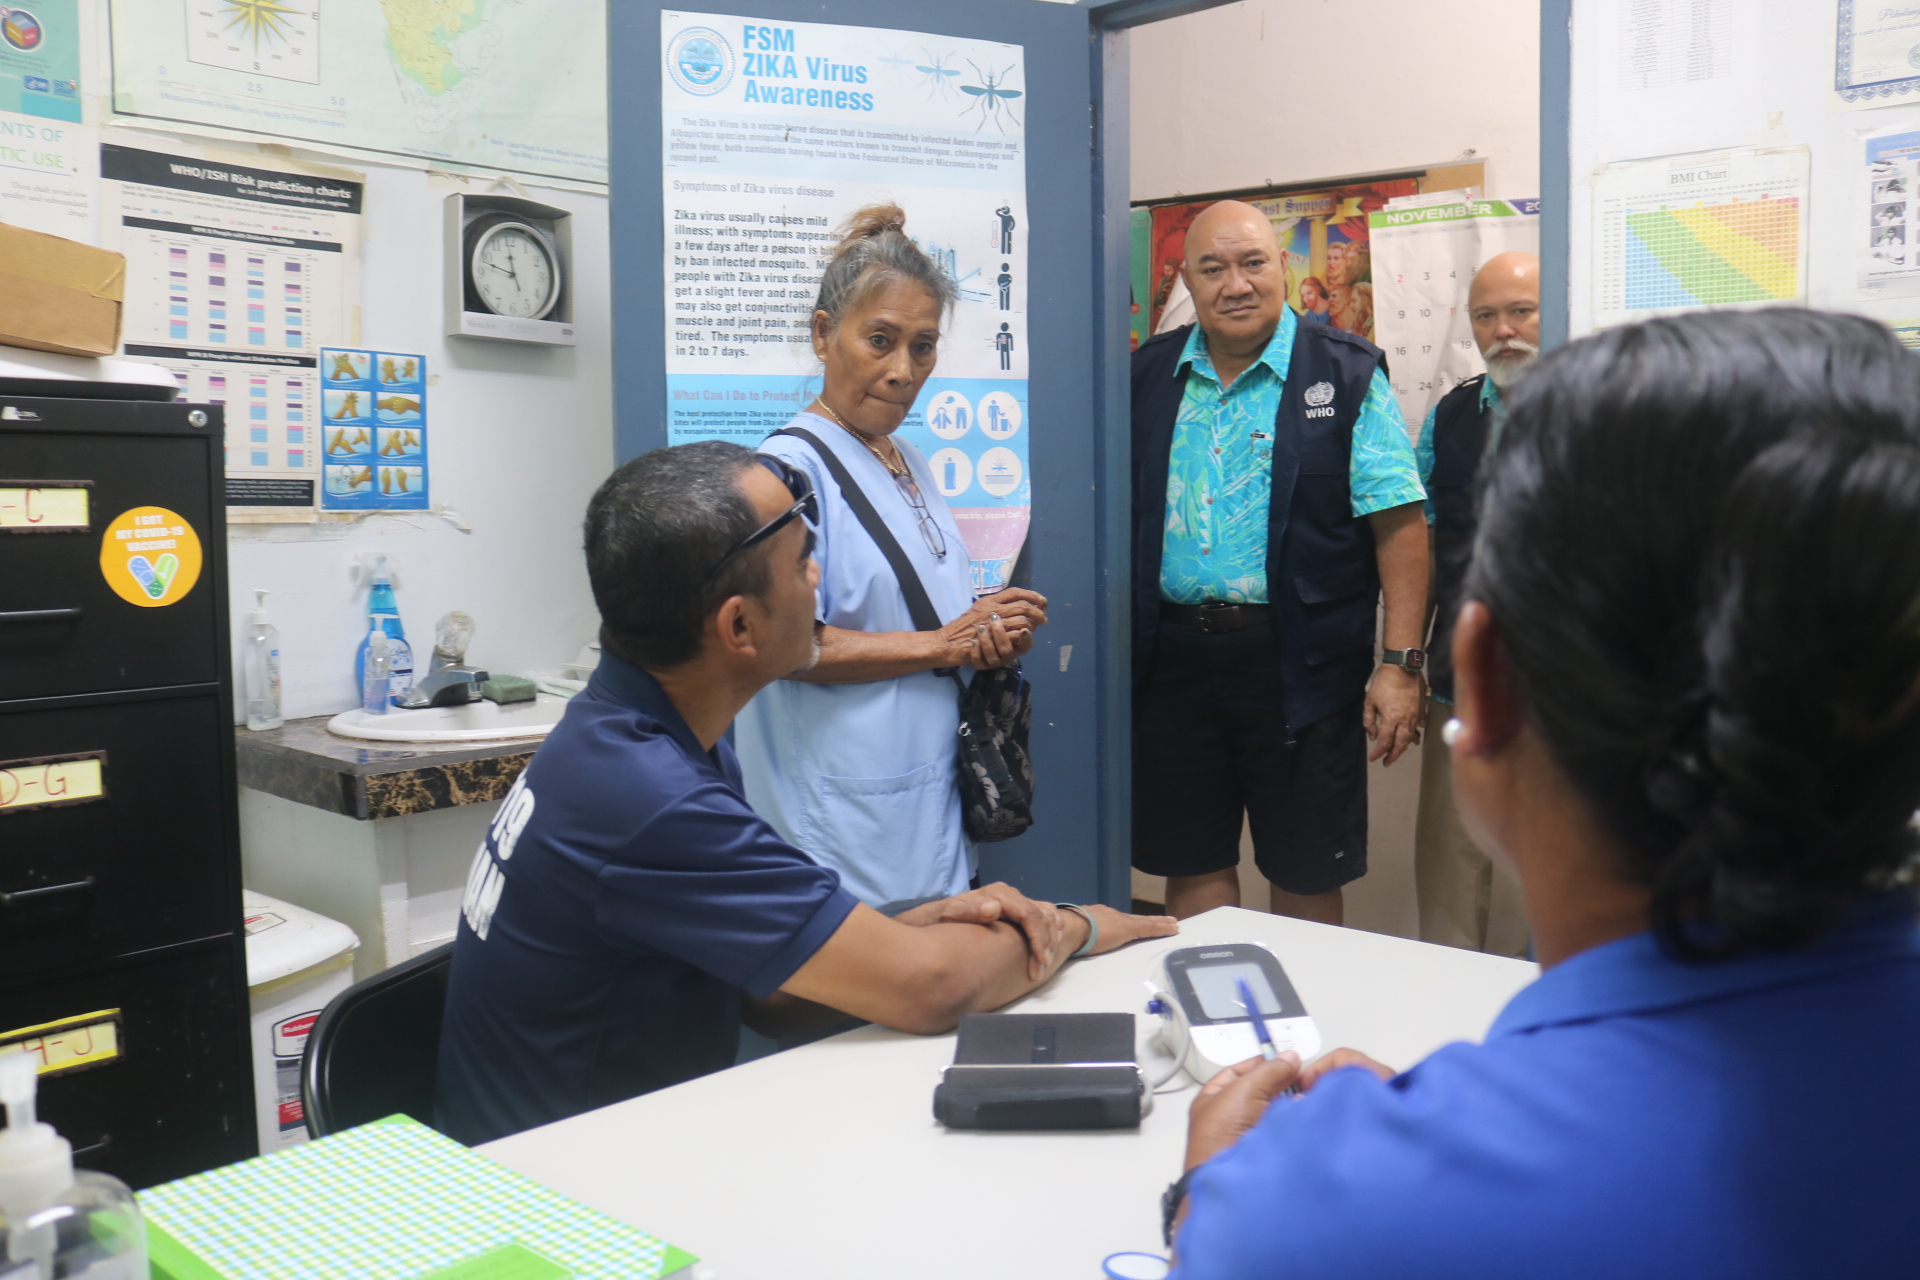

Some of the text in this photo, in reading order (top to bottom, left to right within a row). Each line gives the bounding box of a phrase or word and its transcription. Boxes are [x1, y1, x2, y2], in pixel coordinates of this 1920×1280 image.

[312, 11, 319, 20] E
[743, 25, 795, 52] FSM
[253, 62, 260, 70] S
[743, 52, 867, 84] ZIKA Virus
[744, 79, 874, 111] Awareness
[41, 128, 64, 142] OF
[682, 117, 697, 126] The
[699, 119, 716, 127] Zika
[719, 119, 739, 128] Virus
[809, 125, 838, 135] disease
[840, 128, 855, 137] that
[866, 131, 908, 141] transmitted
[921, 135, 951, 144] infected
[953, 138, 974, 146] Aedes
[670, 129, 713, 139] Albopictus
[716, 132, 746, 141] species
[790, 136, 802, 144] the
[804, 137, 824, 145] same
[827, 139, 854, 147] vectors
[856, 141, 879, 149] known
[891, 144, 921, 153] transmit
[924, 146, 952, 157] dengue,
[1002, 152, 1014, 160] and
[33, 152, 64, 168] USE
[670, 154, 697, 162] recent
[169, 163, 228, 182] WHO/ISH
[231, 173, 255, 187] Risk
[257, 179, 313, 195] prediction
[316, 186, 351, 199] charts
[1670, 169, 1728, 184] BMI Chart
[674, 180, 834, 198] Symptoms of Zika virus disease
[1285, 199, 1331, 215] Supper
[674, 210, 828, 226] Zika virus usually causes mild
[1387, 204, 1492, 224] NOVEMBER
[675, 225, 712, 237] illness;
[717, 227, 738, 236] with
[742, 229, 792, 240] symptoms
[492, 240, 501, 251] 11
[524, 242, 527, 253] 1
[675, 242, 681, 250] a
[685, 240, 704, 251] few
[707, 241, 730, 252] days
[734, 242, 759, 252] after
[772, 246, 806, 255] person
[533, 256, 540, 267] 2
[675, 255, 809, 270] by ban infected mosquito.
[478, 267, 484, 278] 9
[538, 272, 544, 283] 3
[675, 271, 788, 283] people with Zika virus
[1397, 274, 1403, 282] 2
[1424, 272, 1430, 280] 3
[483, 284, 490, 296] 8
[675, 286, 691, 297] get
[705, 287, 734, 297] slight
[738, 288, 763, 297] fever
[768, 288, 785, 298] and
[789, 289, 813, 298] rash.
[509, 303, 516, 314] 6
[524, 299, 530, 310] 5
[676, 302, 696, 312] may
[700, 301, 721, 311] also
[726, 303, 742, 313] get
[1398, 310, 1405, 318] 9
[1420, 309, 1430, 317] 10
[676, 316, 712, 326] muscle
[717, 317, 734, 326] and
[738, 317, 761, 328] joint
[765, 318, 790, 329] pain,
[676, 331, 783, 343] tired. The symptoms
[676, 346, 749, 358] in 2 to 7 days.
[1396, 347, 1406, 355] 16
[1461, 341, 1471, 349] 19
[1419, 382, 1432, 390] 24
[673, 390, 799, 401] What Can I Do to Protect
[1306, 407, 1335, 418] WHO
[135, 515, 163, 525] I GOT
[116, 527, 184, 540] MY COVID-19
[125, 540, 177, 552] VACCINE!
[1199, 950, 1234, 961] OMRON
